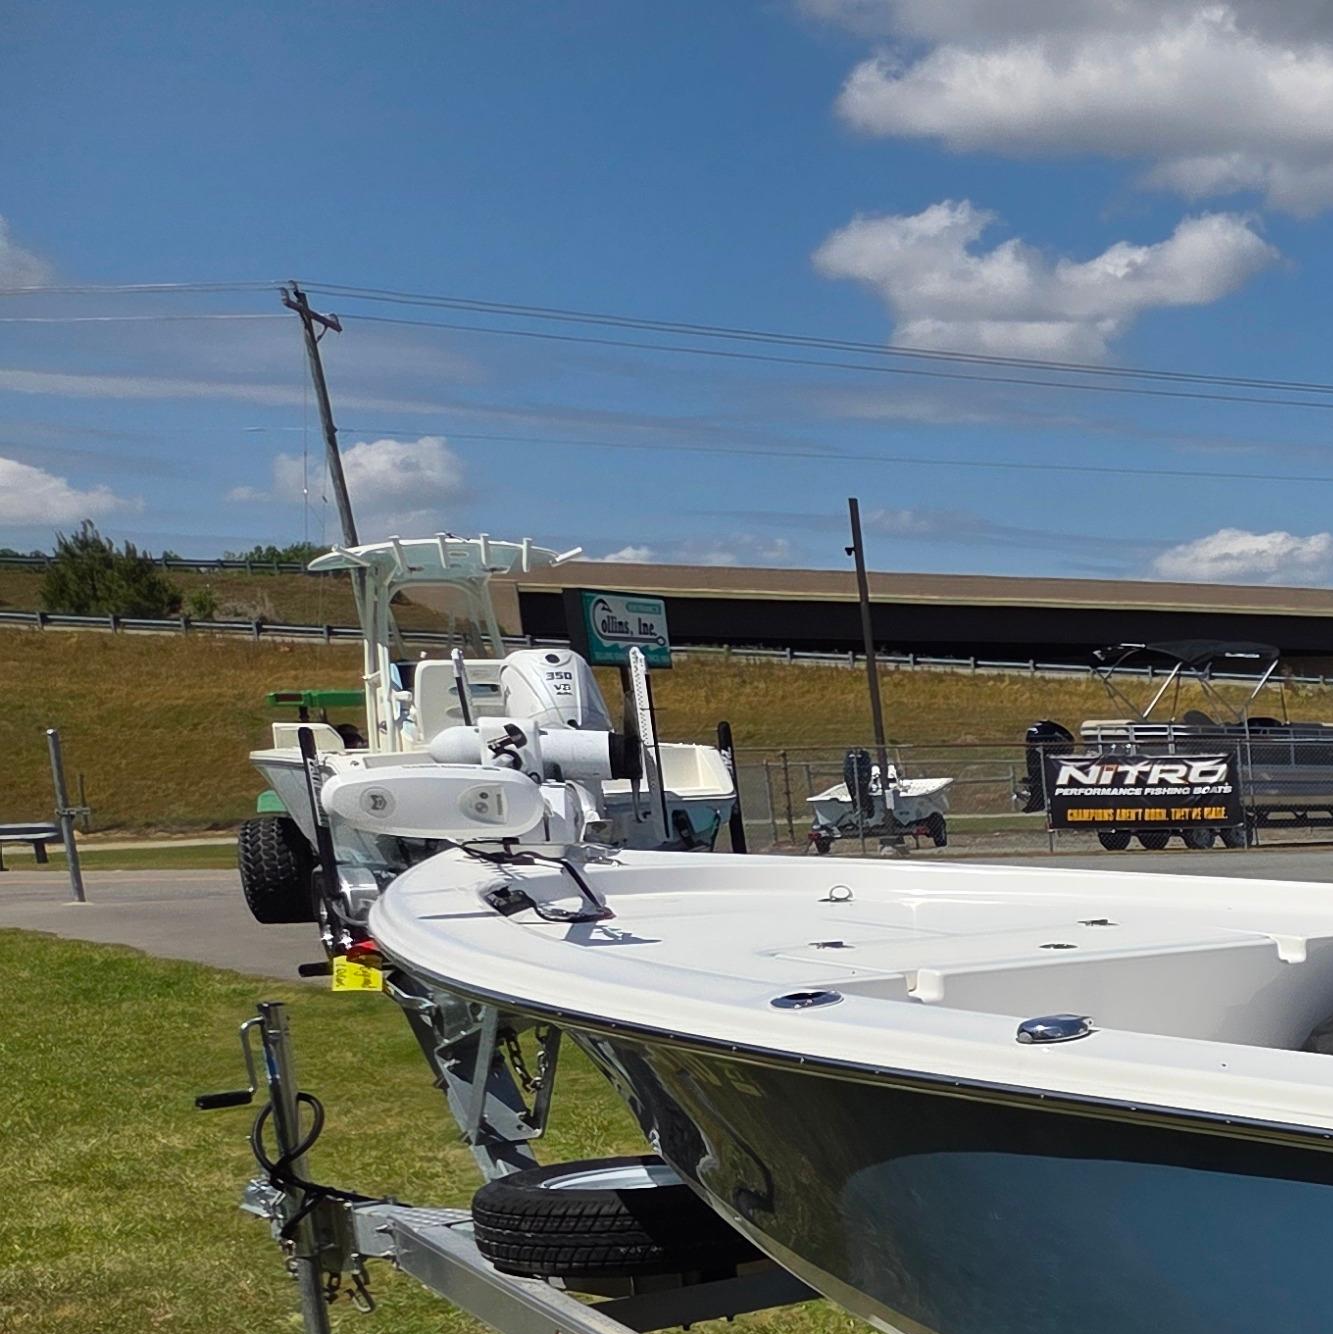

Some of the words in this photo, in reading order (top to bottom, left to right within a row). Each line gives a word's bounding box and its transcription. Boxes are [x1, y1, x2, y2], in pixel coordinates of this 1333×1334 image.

[545, 671, 573, 681] 350
[553, 683, 572, 691] V8
[1055, 787, 1142, 796] PERFORMANCE
[1144, 786, 1191, 796] FISHING
[1193, 784, 1232, 795] BOATS
[1067, 808, 1114, 822] CHAMPIONS
